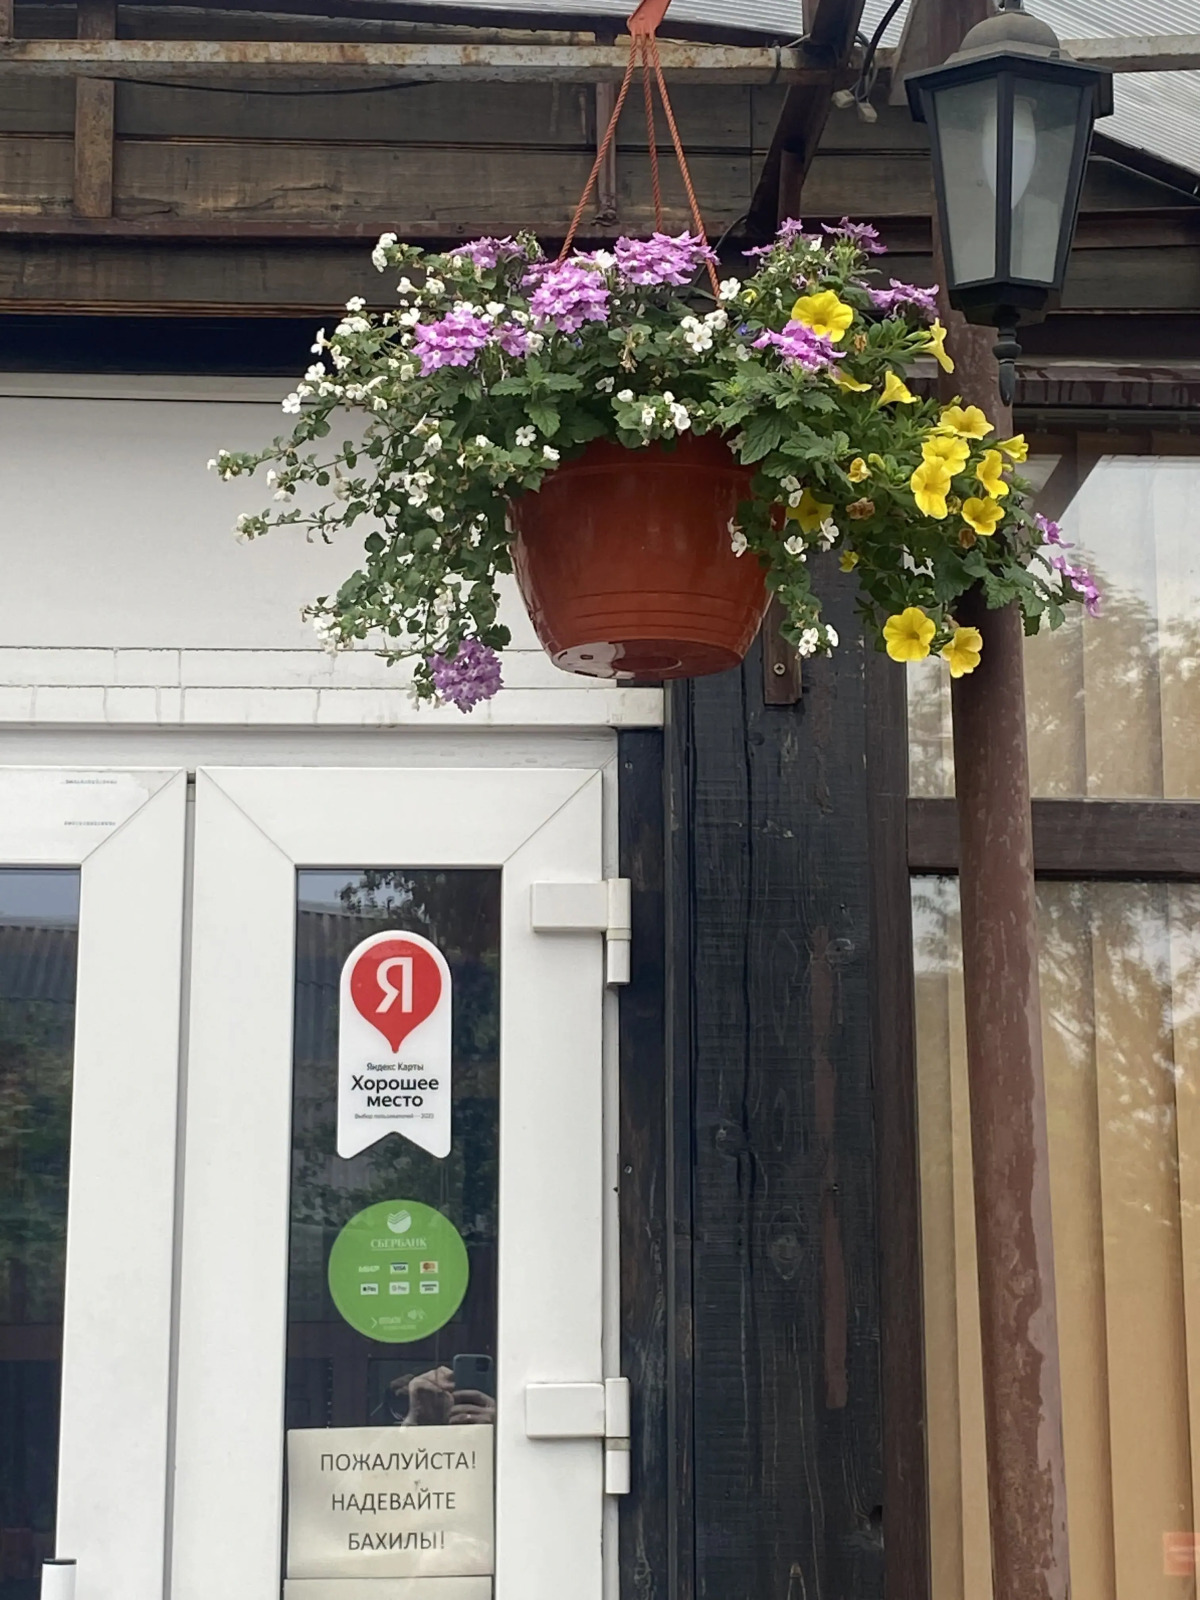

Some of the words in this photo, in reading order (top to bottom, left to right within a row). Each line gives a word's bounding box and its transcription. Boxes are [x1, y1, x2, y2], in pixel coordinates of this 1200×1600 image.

[375, 956, 413, 1014] Я
[366, 1062, 396, 1072] Яндекс
[397, 1062, 424, 1072] Карты
[351, 1075, 439, 1094] Хорошее
[367, 1095, 424, 1107] место
[370, 1238, 427, 1248] СБЕРБАНК
[320, 1448, 476, 1471] ПОЖАЛУЙСТА!
[332, 1488, 456, 1515] НАДЕВАЙТЕ
[348, 1531, 445, 1550] БАХИЛЫ!
